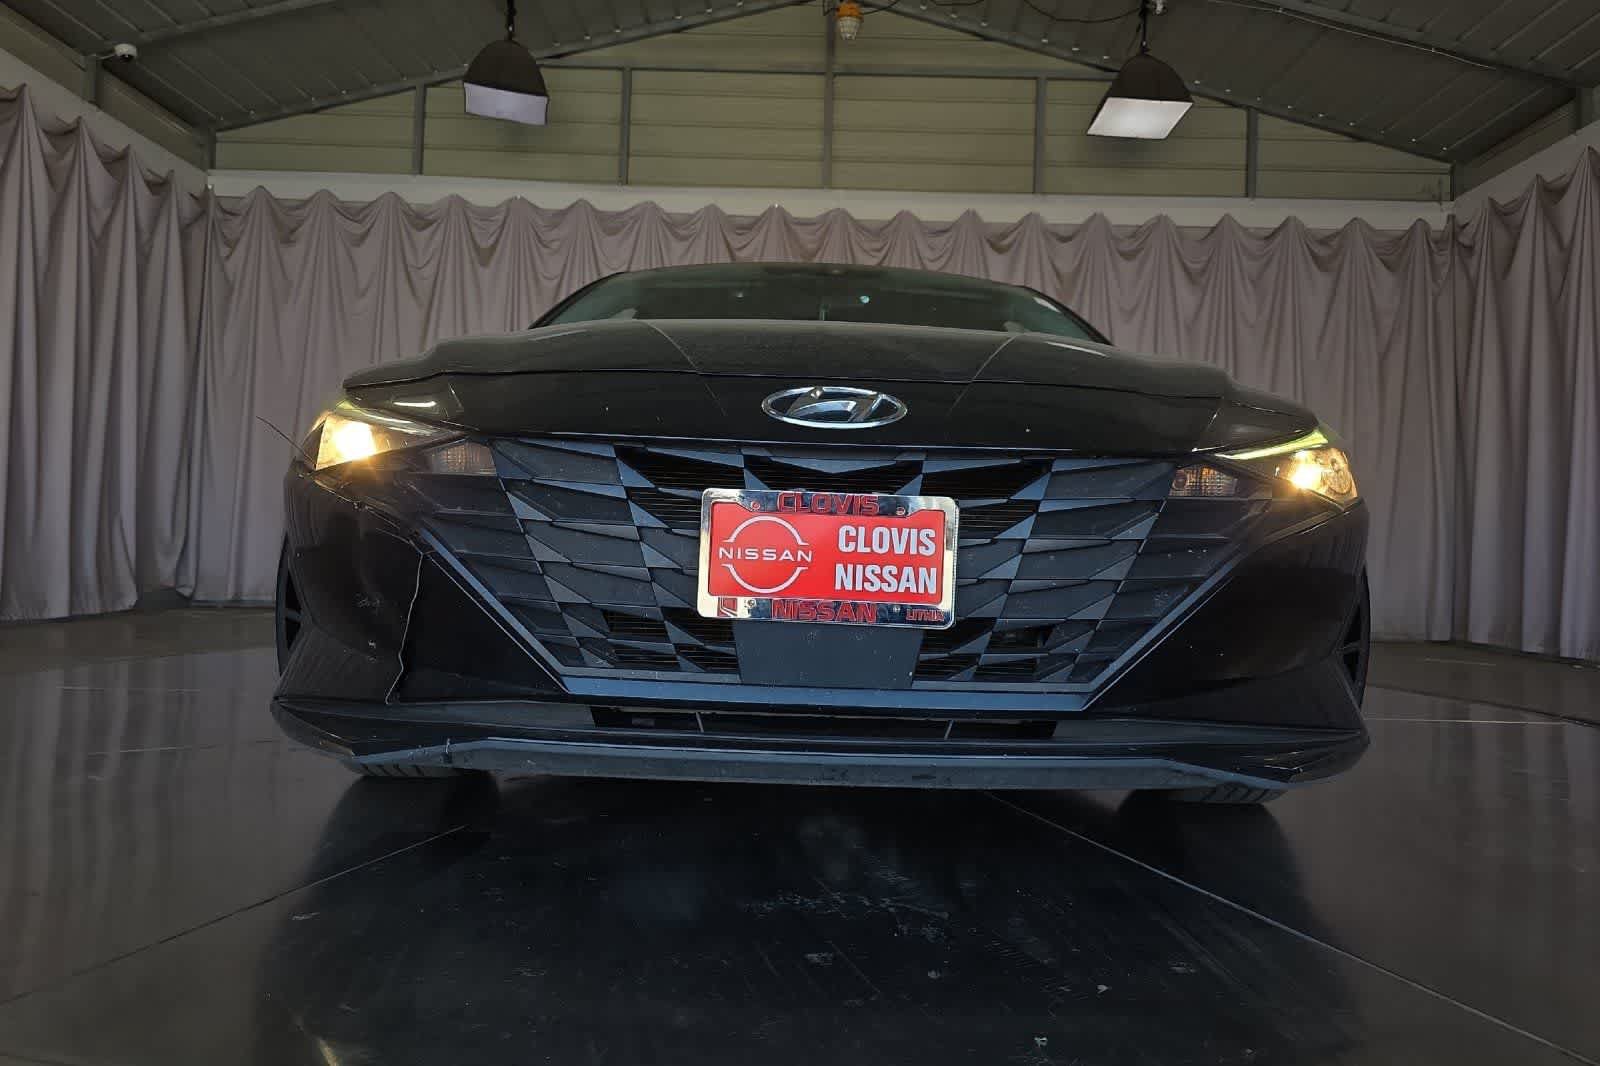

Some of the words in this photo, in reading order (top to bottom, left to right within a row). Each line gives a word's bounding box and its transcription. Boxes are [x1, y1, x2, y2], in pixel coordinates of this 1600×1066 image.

[777, 491, 880, 516] CLOVIS
[838, 525, 936, 556] CLOVIS
[719, 547, 812, 563] NISSAN
[835, 564, 937, 595] NISSAN
[772, 599, 877, 624] NISSAN
